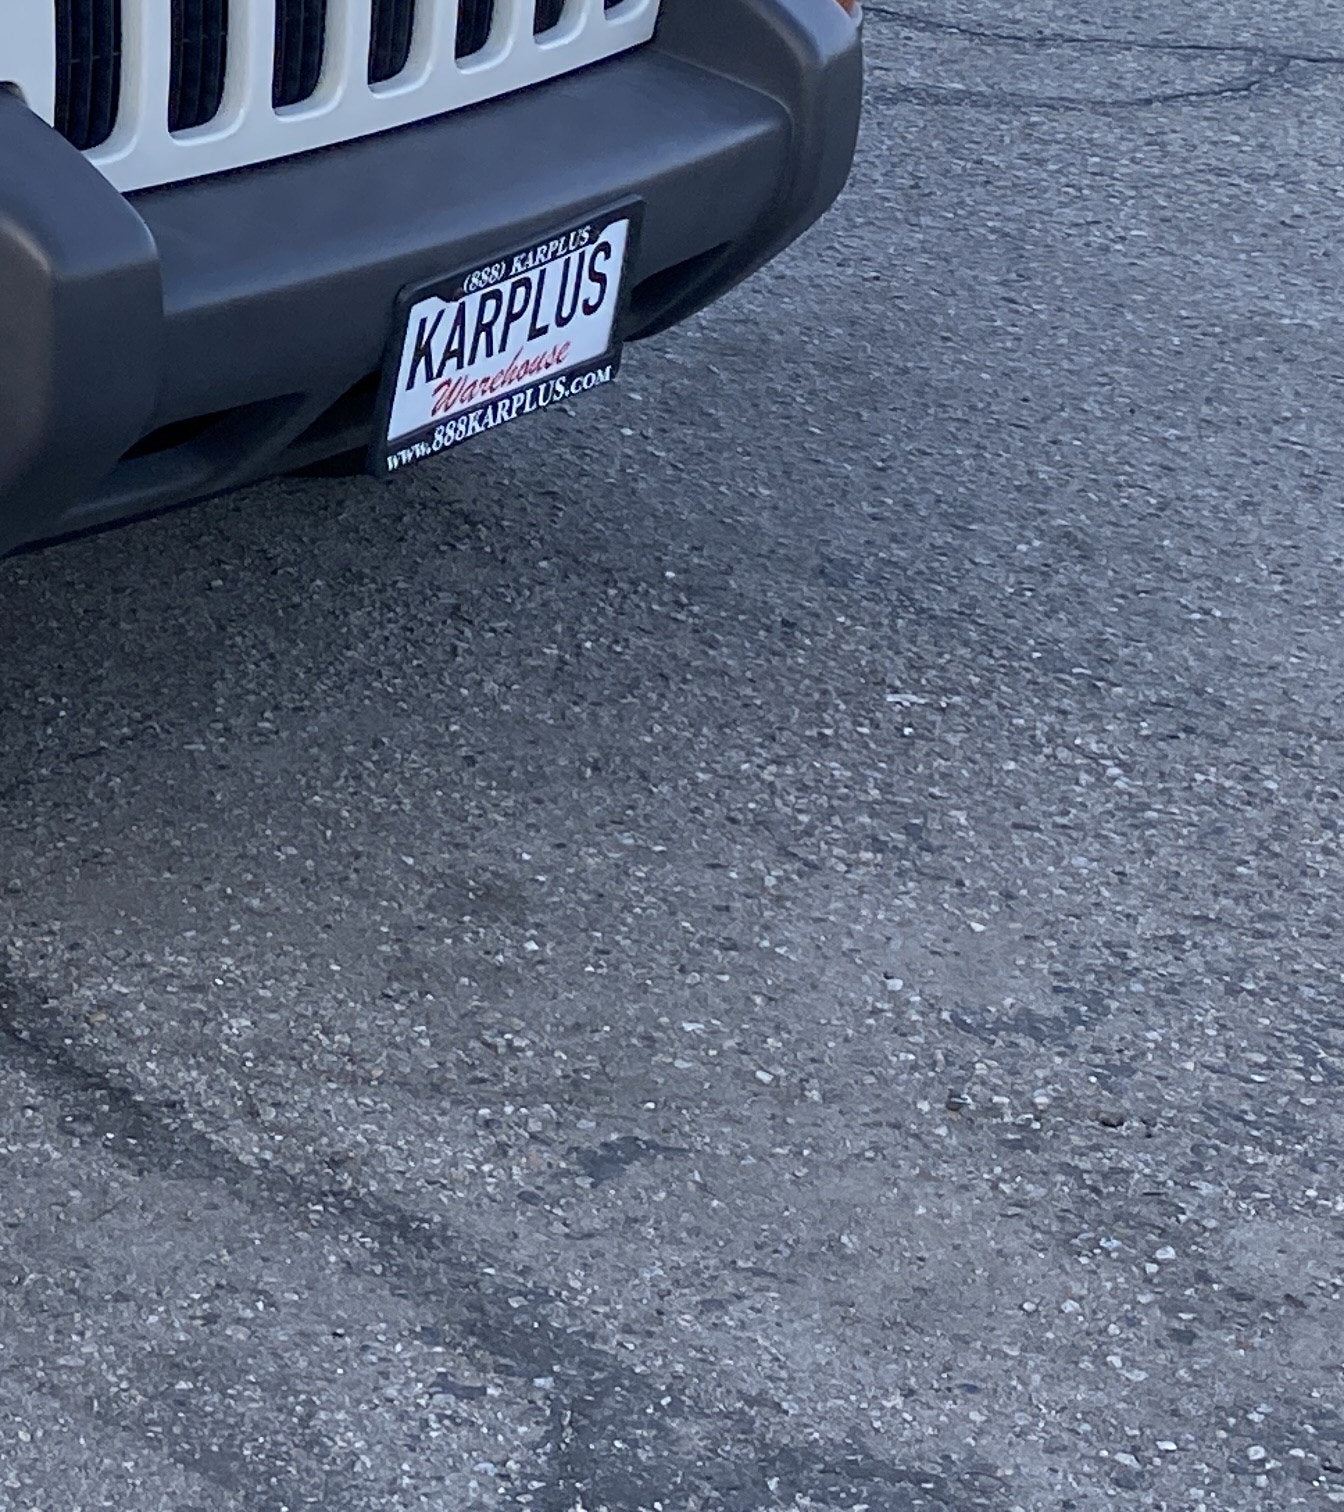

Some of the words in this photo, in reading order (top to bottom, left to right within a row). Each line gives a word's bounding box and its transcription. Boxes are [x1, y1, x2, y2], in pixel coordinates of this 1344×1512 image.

[462, 262, 506, 294] (888)
[509, 225, 592, 277] KARPLUS
[404, 240, 612, 391] KARPLUS
[430, 339, 572, 417] Warehouse
